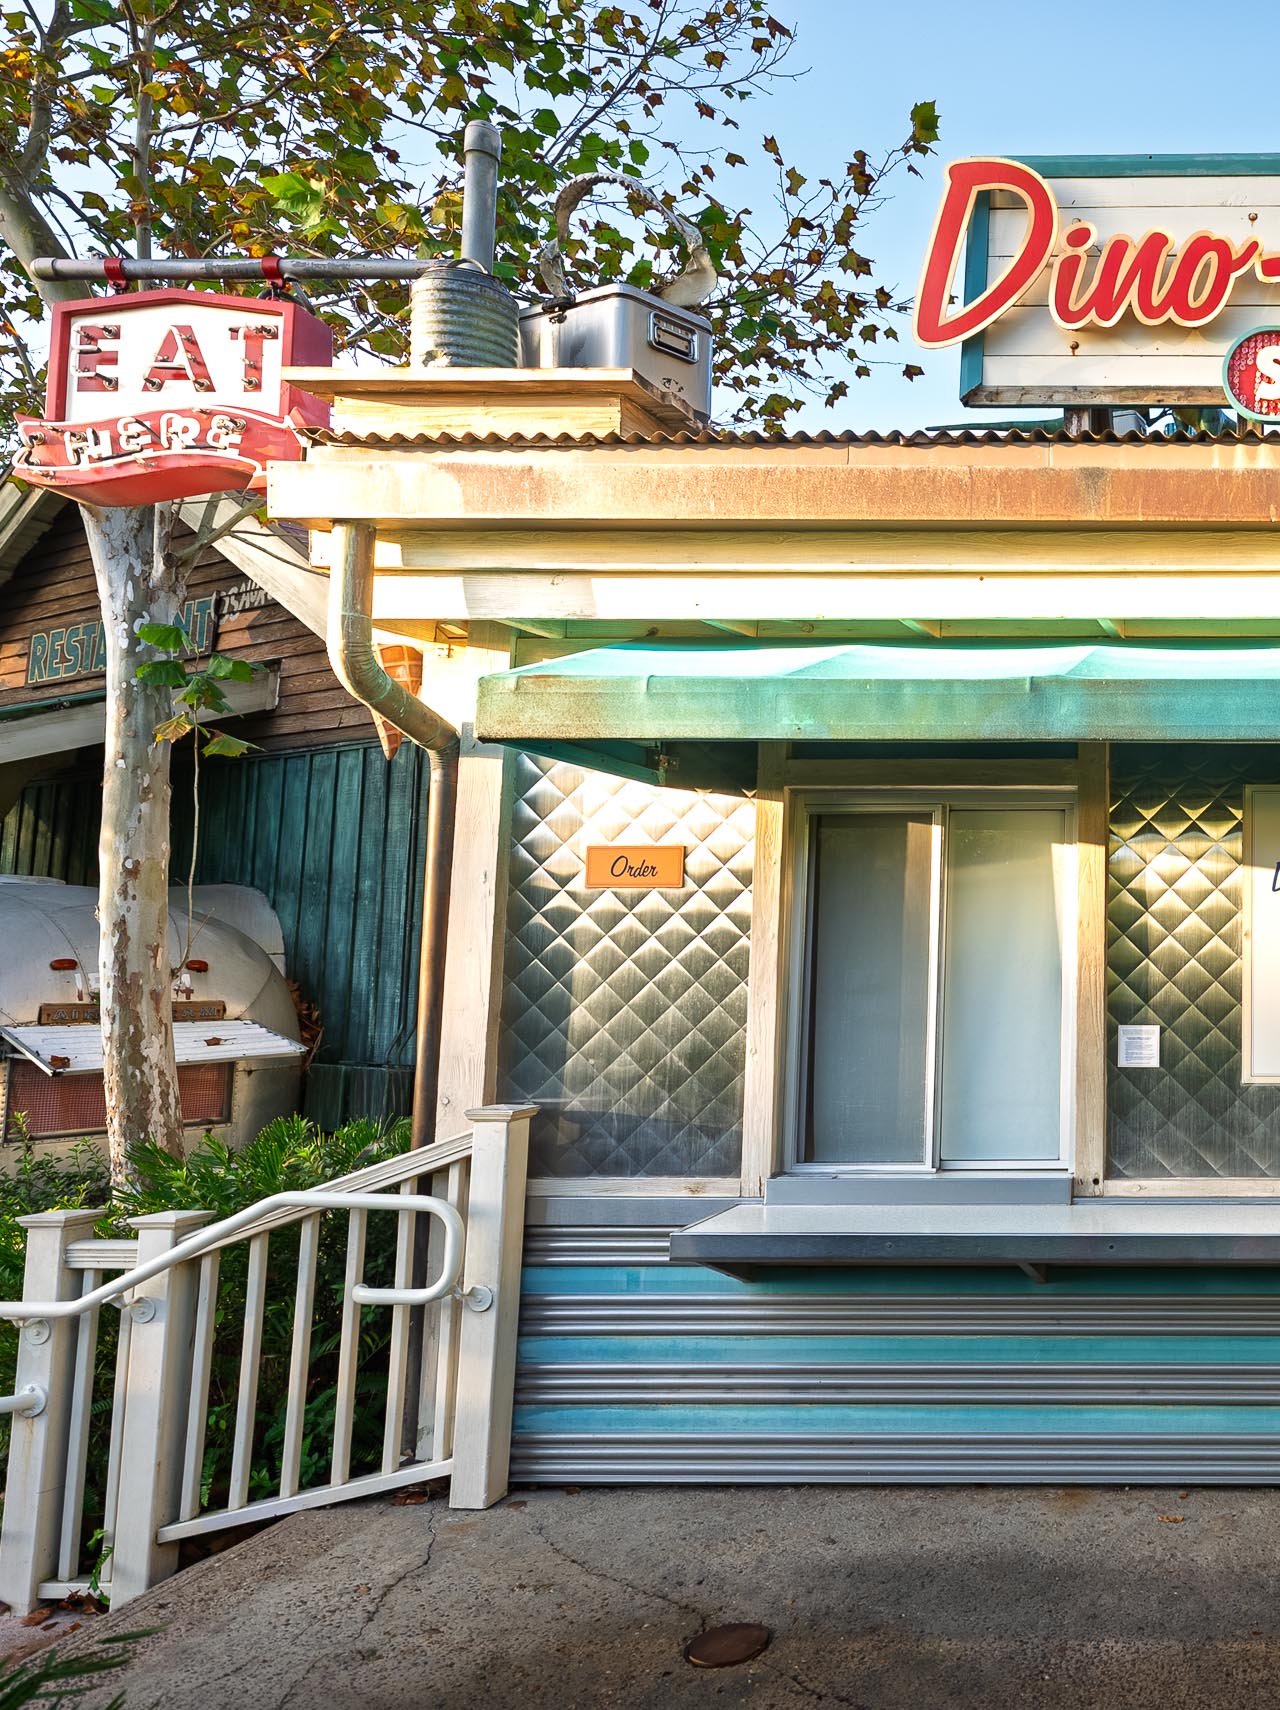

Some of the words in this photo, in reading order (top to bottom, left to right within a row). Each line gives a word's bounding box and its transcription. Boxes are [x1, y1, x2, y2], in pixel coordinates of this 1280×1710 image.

[71, 323, 280, 392] EAT
[63, 412, 244, 471] HERE
[610, 855, 658, 878] Order
